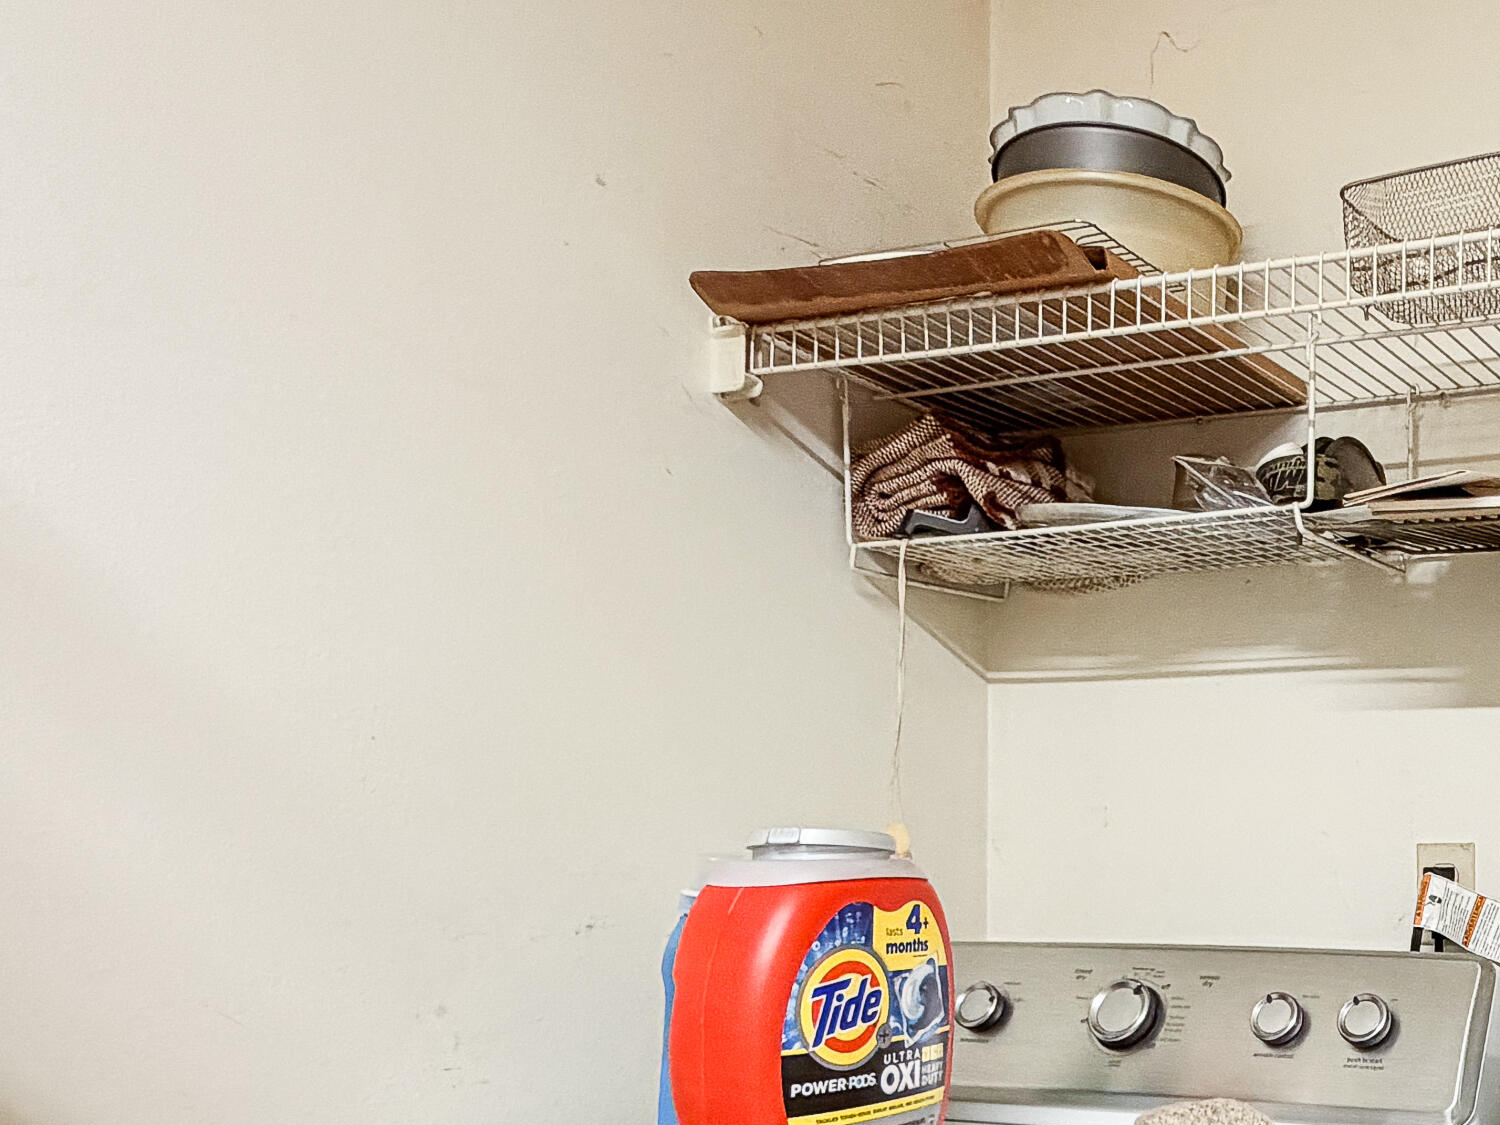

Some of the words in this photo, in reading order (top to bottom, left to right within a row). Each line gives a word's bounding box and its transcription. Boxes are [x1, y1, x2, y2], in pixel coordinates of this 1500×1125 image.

[885, 937, 929, 955] months
[811, 977, 882, 1048] Tide
[883, 1048, 921, 1065] ULTRA
[880, 1060, 921, 1095] OXI
[921, 1071, 944, 1087] DUTY
